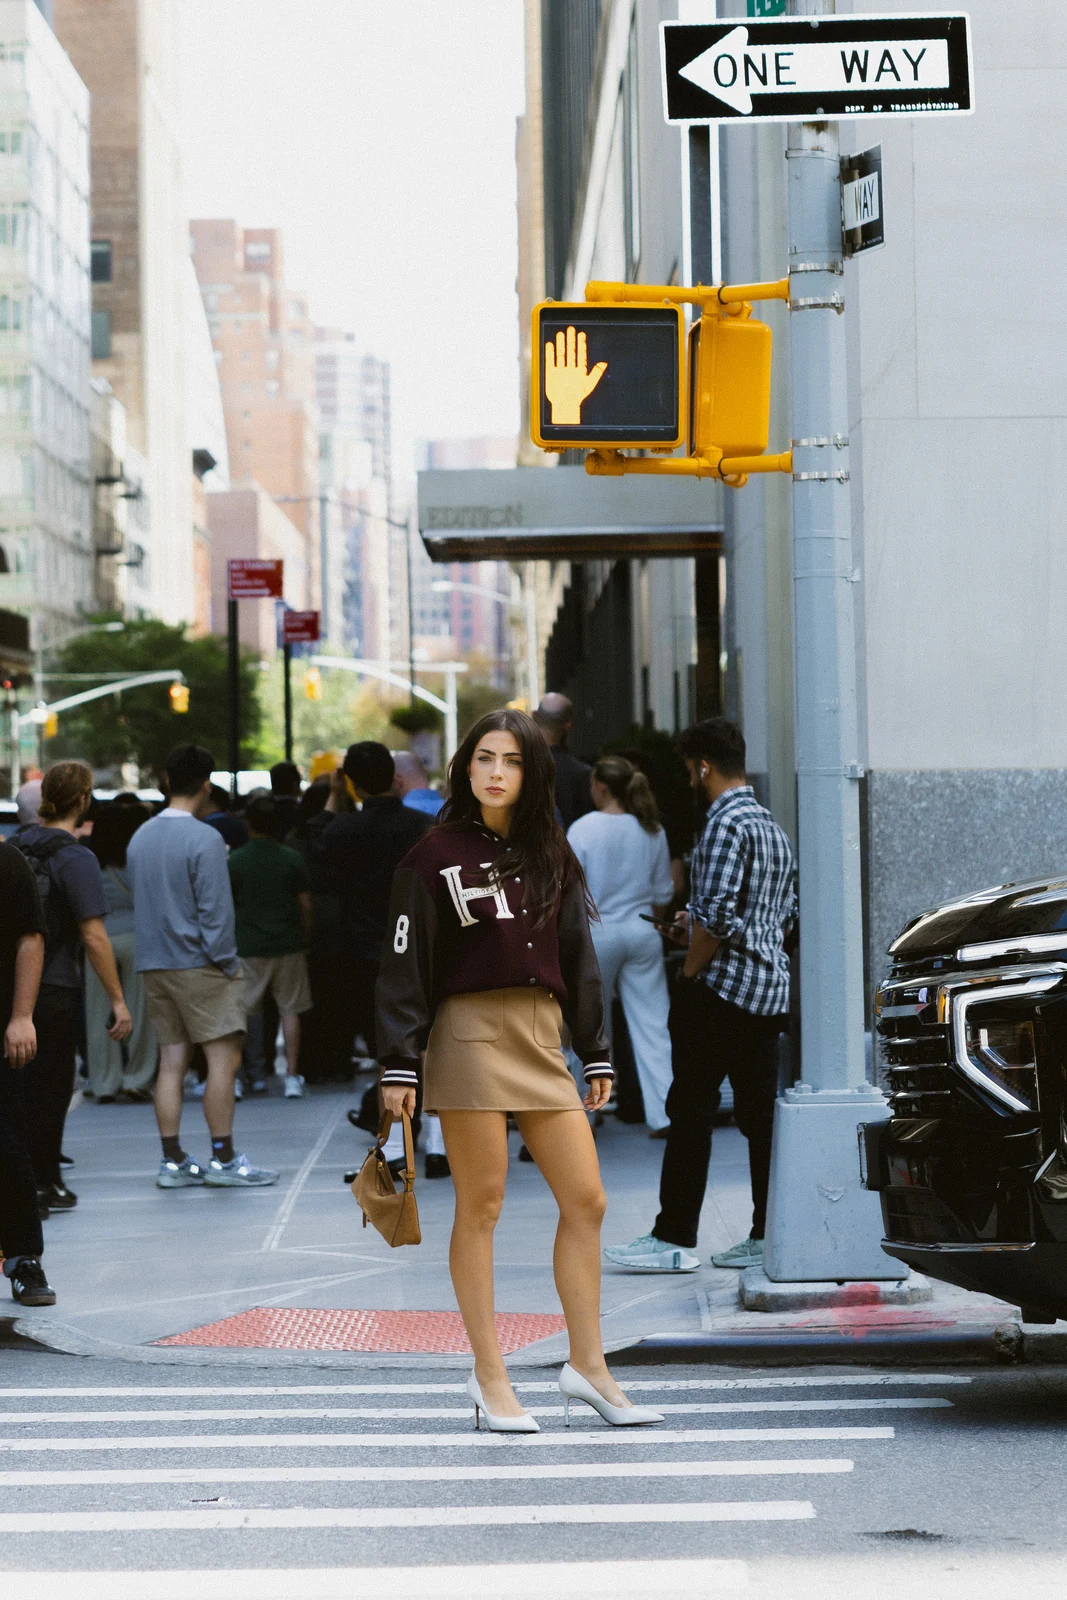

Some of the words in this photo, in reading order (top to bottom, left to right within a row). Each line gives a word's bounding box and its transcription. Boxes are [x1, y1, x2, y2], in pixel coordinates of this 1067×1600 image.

[713, 51, 797, 88] ONE
[840, 48, 927, 84] WAY
[845, 105, 865, 113] DEPT
[890, 102, 959, 112] TRANSPORTATION
[854, 179, 875, 222] WAY
[428, 504, 523, 529] EDITION
[439, 862, 515, 928] H
[393, 914, 410, 954] 8
